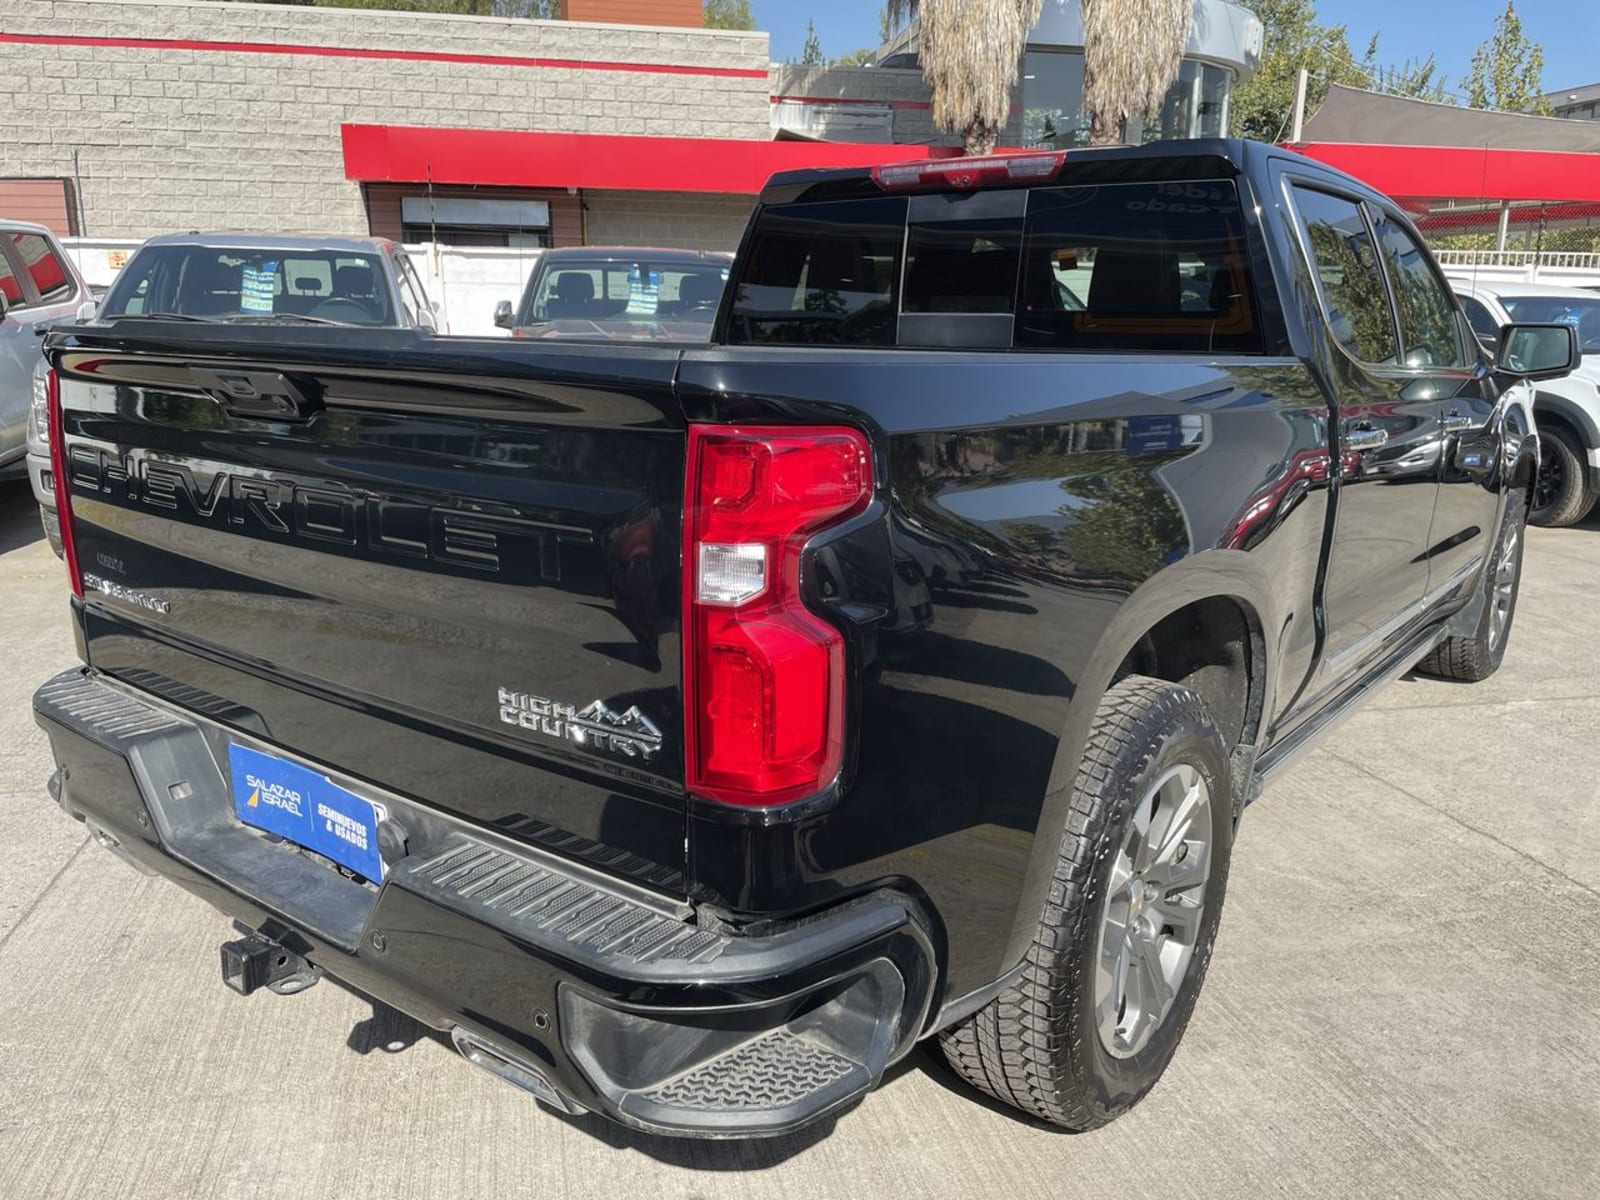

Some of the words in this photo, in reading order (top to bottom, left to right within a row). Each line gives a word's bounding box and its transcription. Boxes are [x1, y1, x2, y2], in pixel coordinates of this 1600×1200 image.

[69, 445, 593, 582] CHEVROLET
[498, 686, 576, 721] HIGH
[500, 705, 661, 761] COUNTRY
[246, 774, 302, 805] SALAZAR
[262, 791, 303, 817] ISRAEL
[317, 803, 367, 837] SEMINUEVOS
[326, 820, 333, 832] &
[335, 823, 368, 851] USADOS
